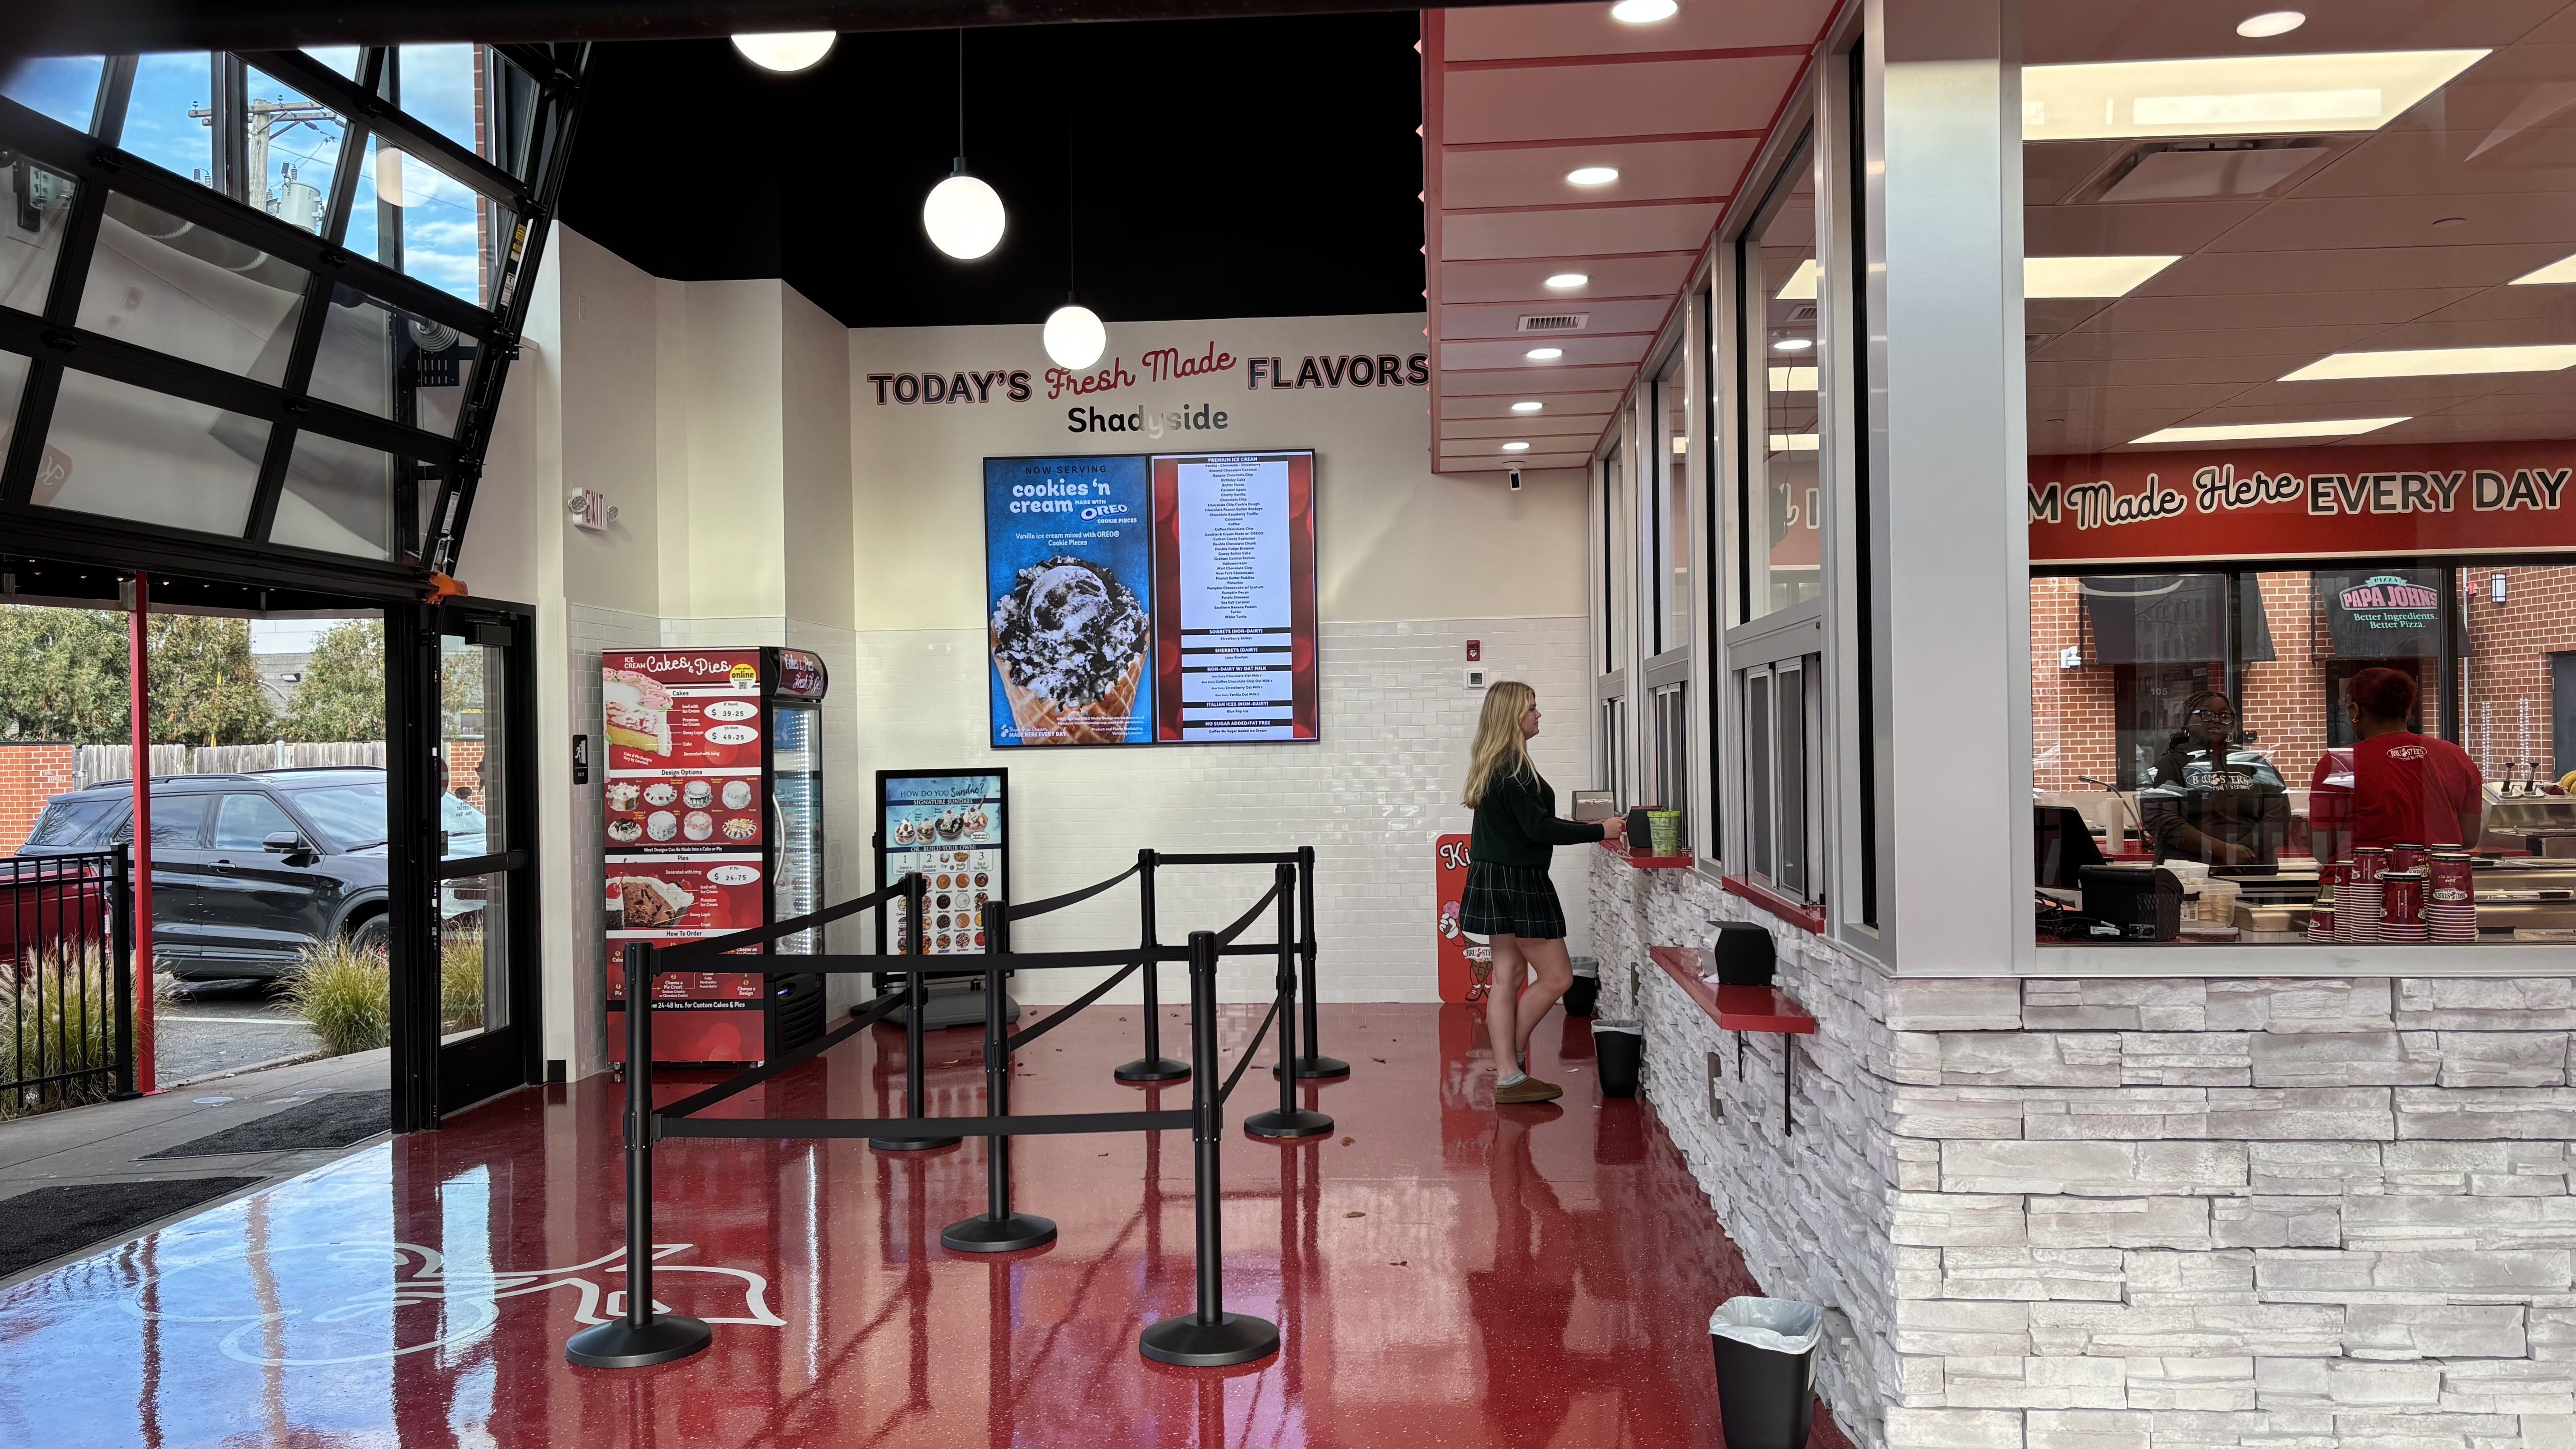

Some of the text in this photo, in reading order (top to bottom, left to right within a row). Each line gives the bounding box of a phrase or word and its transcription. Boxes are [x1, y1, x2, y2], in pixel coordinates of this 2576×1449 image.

[867, 340, 1429, 405] TODAY'S Fresh Made FLAVORS
[1067, 403, 1229, 440] Shadyside
[1012, 478, 1088, 497] cookies
[2065, 473, 2188, 530] Made
[2192, 463, 2304, 514] Here
[2308, 470, 2466, 516] EVERY
[2472, 468, 2573, 511] DAY
[586, 490, 605, 524] EXIT
[1010, 500, 1073, 513] cream
[1080, 505, 1128, 520] OREO
[2343, 586, 2438, 607] PAPA JOHN'S
[2383, 612, 2437, 621] Ingredients.
[647, 654, 690, 672] Cakes
[694, 658, 731, 676] Pies
[731, 671, 754, 679] online
[712, 708, 716, 716] $
[951, 783, 984, 797] Sundae?
[926, 854, 932, 862] 2
[979, 851, 984, 860] 3
[714, 872, 718, 880] $
